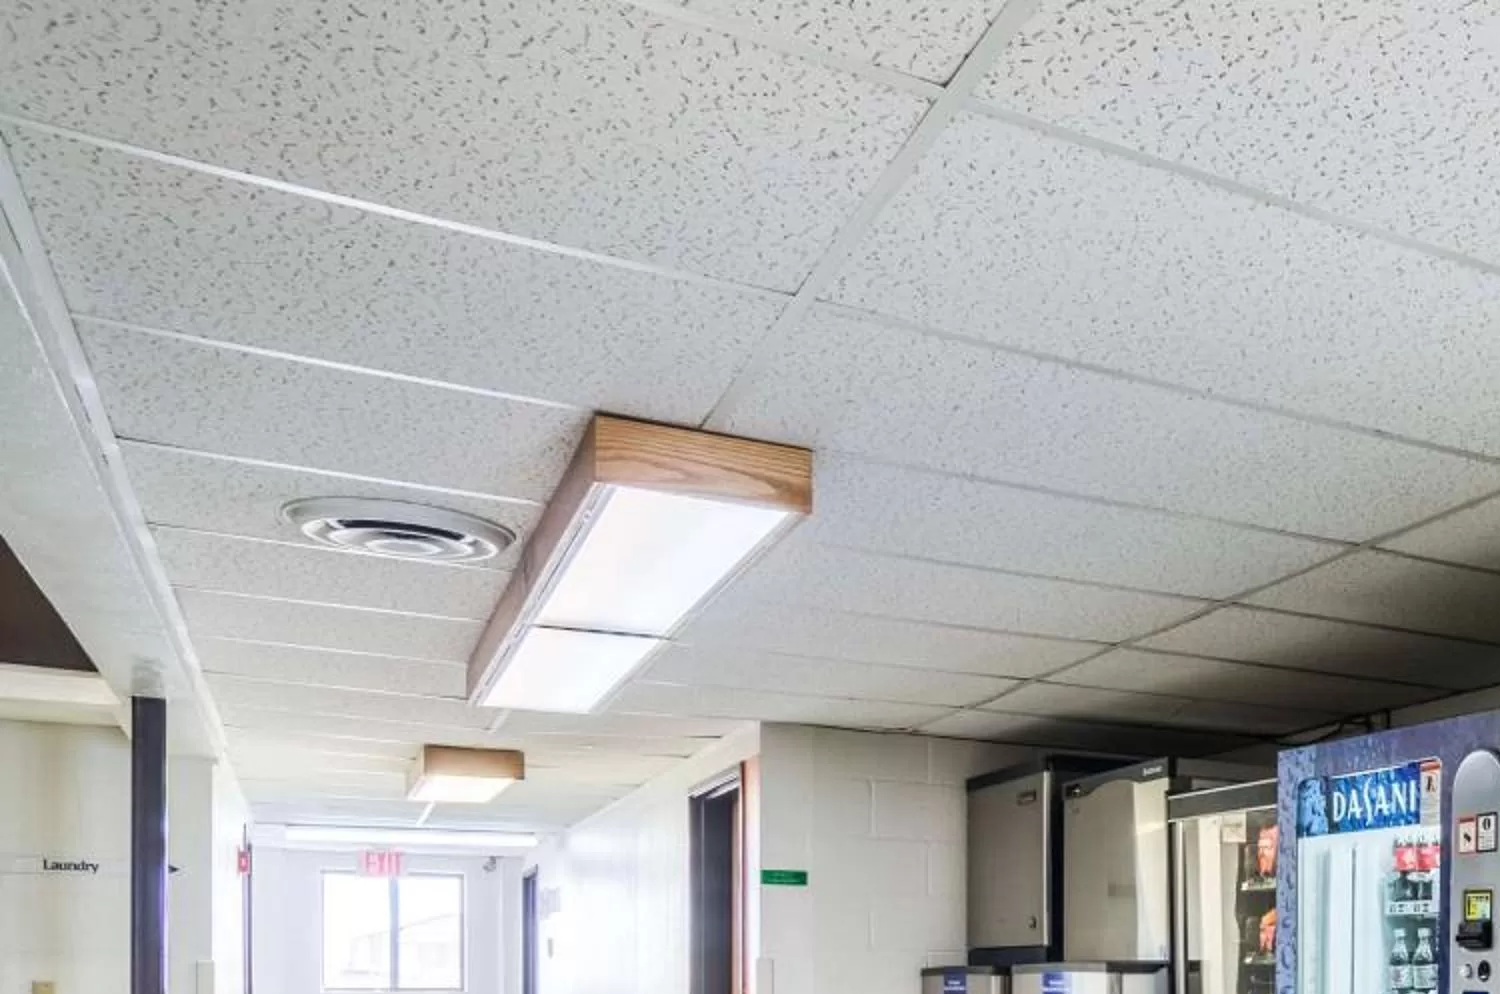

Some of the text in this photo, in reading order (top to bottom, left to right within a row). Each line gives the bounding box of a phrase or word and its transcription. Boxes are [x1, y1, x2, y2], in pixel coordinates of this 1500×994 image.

[1333, 778, 1417, 826] DASANI
[43, 858, 99, 874] Laundry
[365, 851, 402, 873] EXIT
